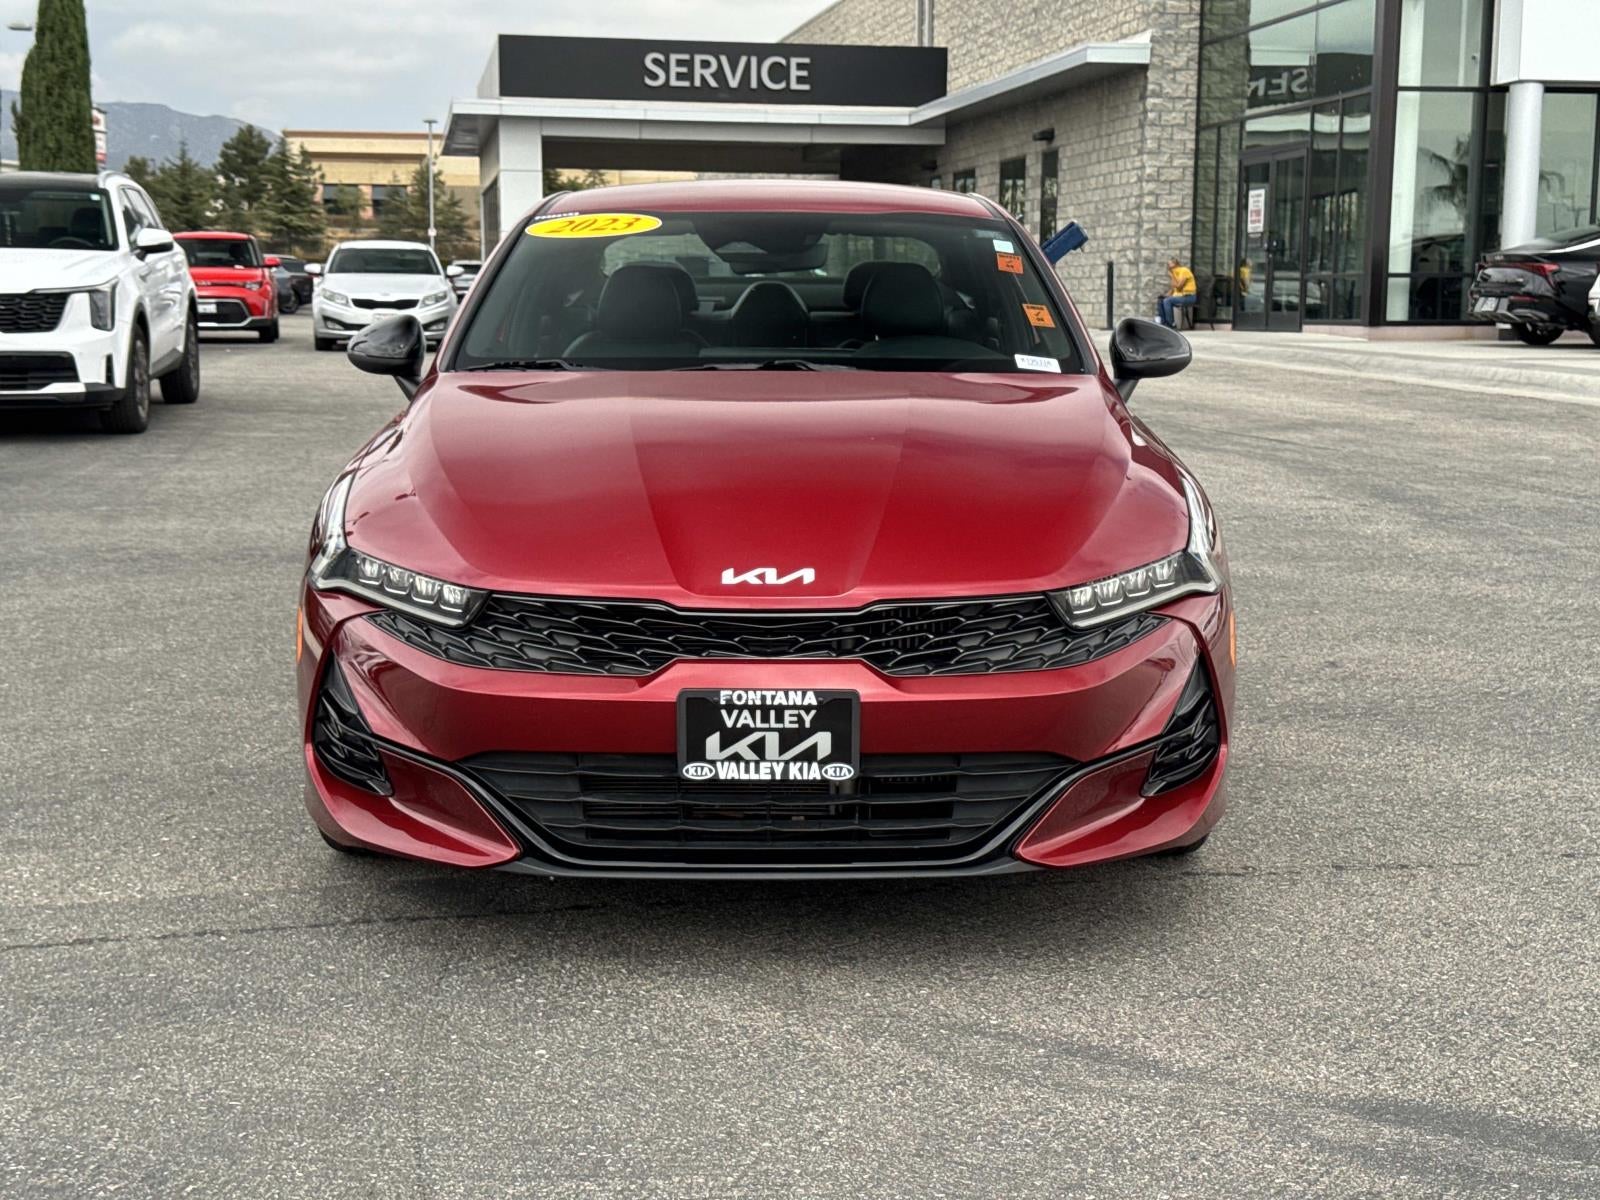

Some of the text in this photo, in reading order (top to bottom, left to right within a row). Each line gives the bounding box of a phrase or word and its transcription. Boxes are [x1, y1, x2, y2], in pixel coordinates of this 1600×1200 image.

[644, 52, 811, 91] SERVICE
[545, 217, 641, 234] 2023
[721, 568, 816, 585] KIA
[719, 690, 818, 706] FONTANA
[720, 709, 817, 728] VALLEY
[705, 731, 832, 761] KIA
[688, 762, 851, 780] KIA VALLEY KIA KIA
